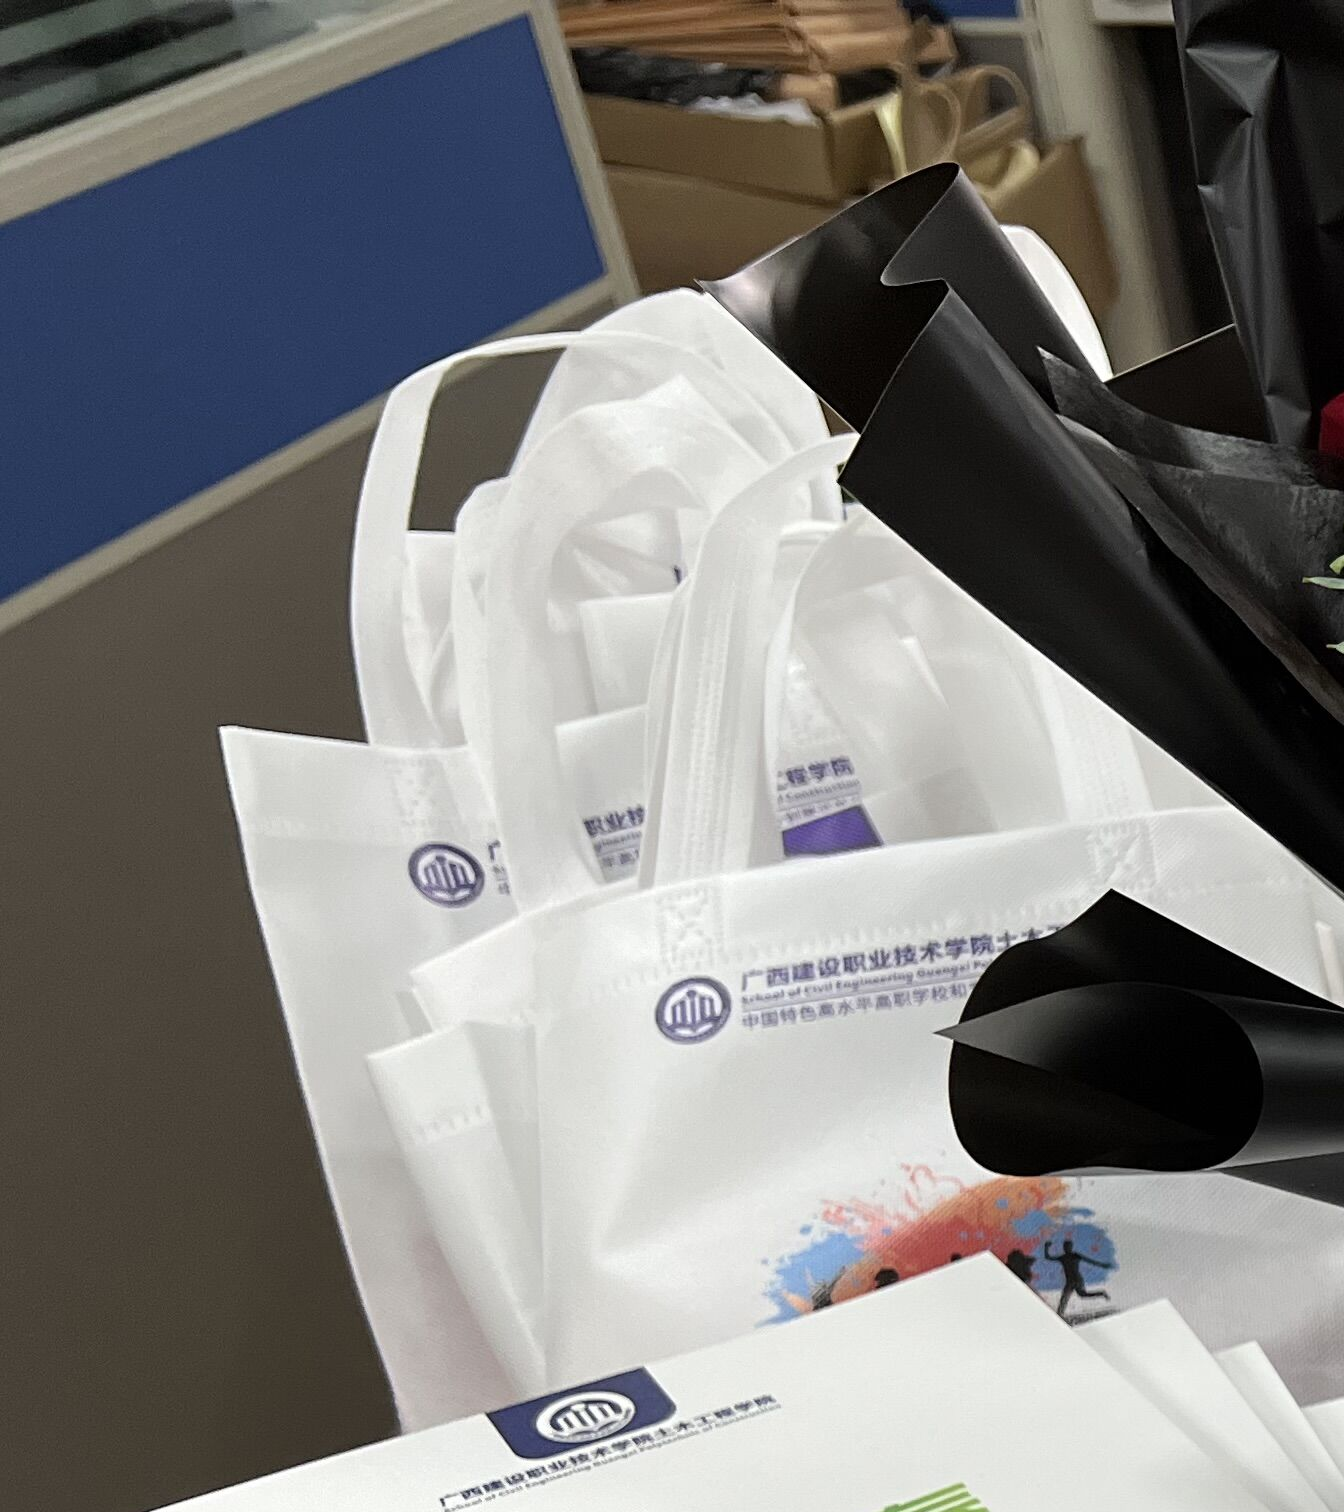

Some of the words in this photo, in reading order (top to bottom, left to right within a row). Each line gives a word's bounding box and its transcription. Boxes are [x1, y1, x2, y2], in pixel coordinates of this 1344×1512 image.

[742, 980, 978, 1030] 中国特色高水平高职学校和
